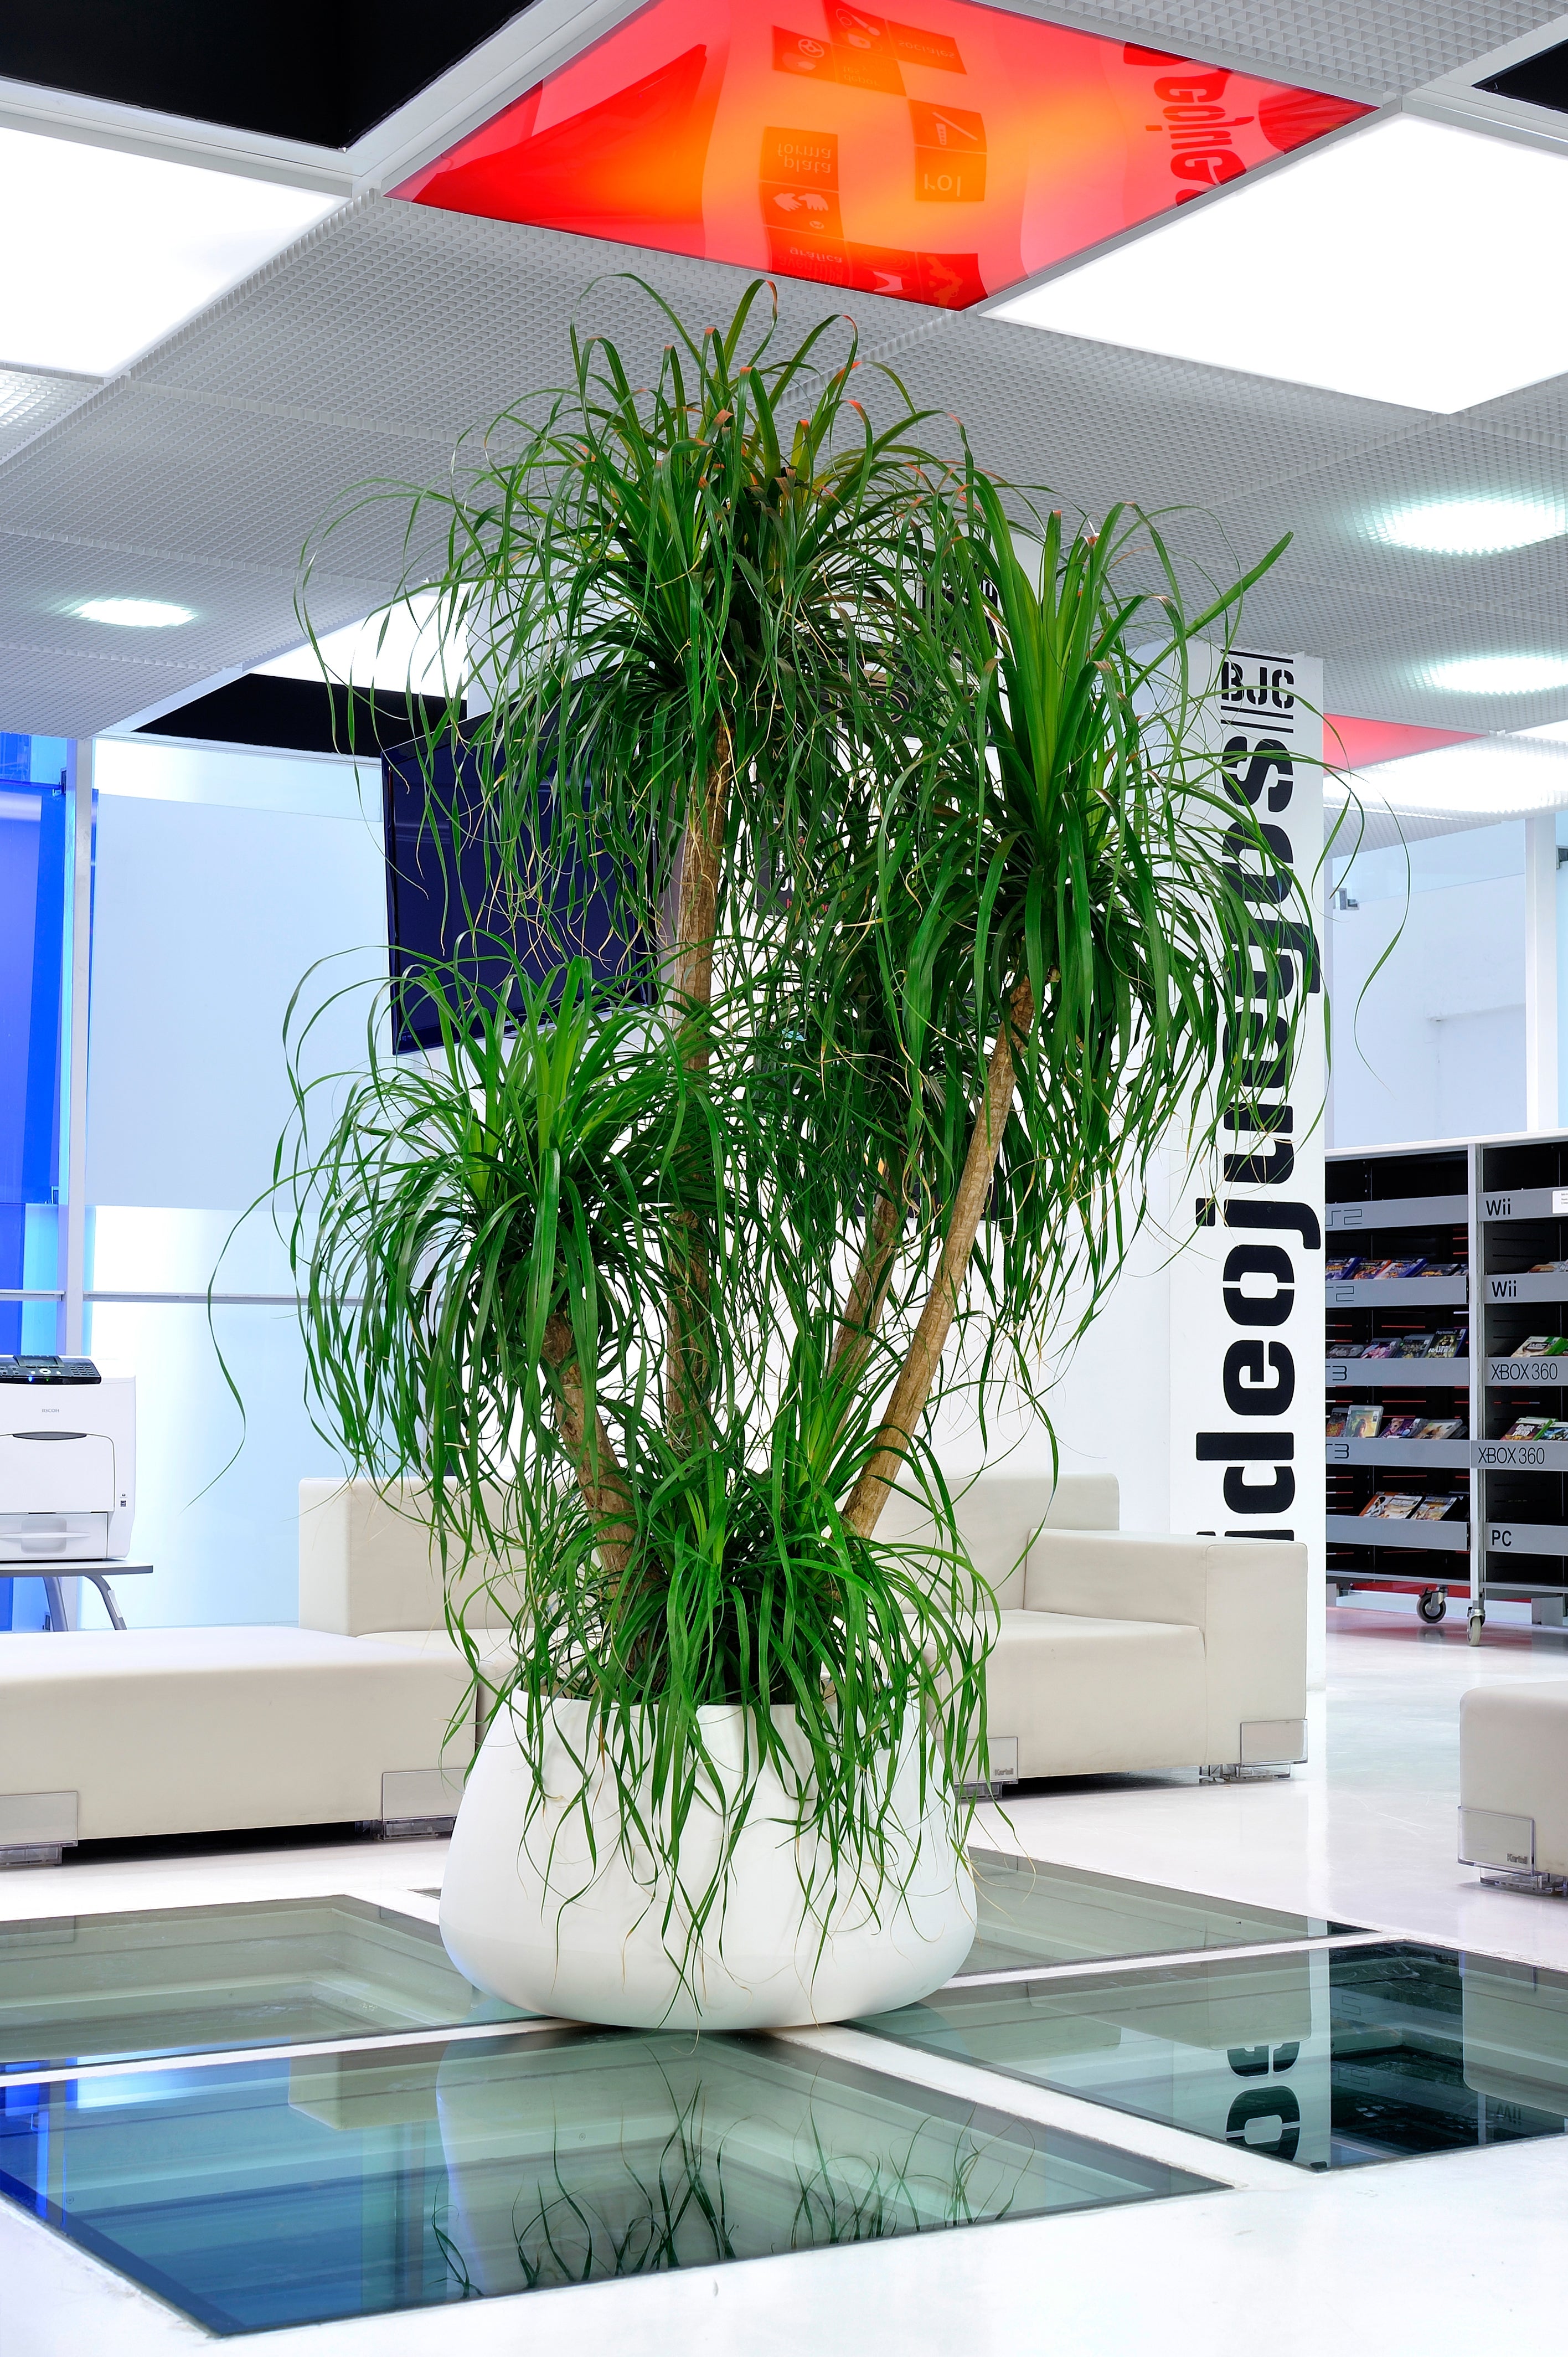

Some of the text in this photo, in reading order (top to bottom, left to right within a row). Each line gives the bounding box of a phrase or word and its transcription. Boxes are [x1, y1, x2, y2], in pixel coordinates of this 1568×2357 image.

[1221, 661, 1294, 709] BJC
[1195, 735, 1321, 1541] deojuegos
[1486, 1198, 1511, 1217] Wii
[1492, 1280, 1517, 1298] Wii
[1491, 1363, 1558, 1380] XBOX 360
[1478, 1447, 1545, 1465] XBOX 360
[1492, 1530, 1512, 1547] PC
